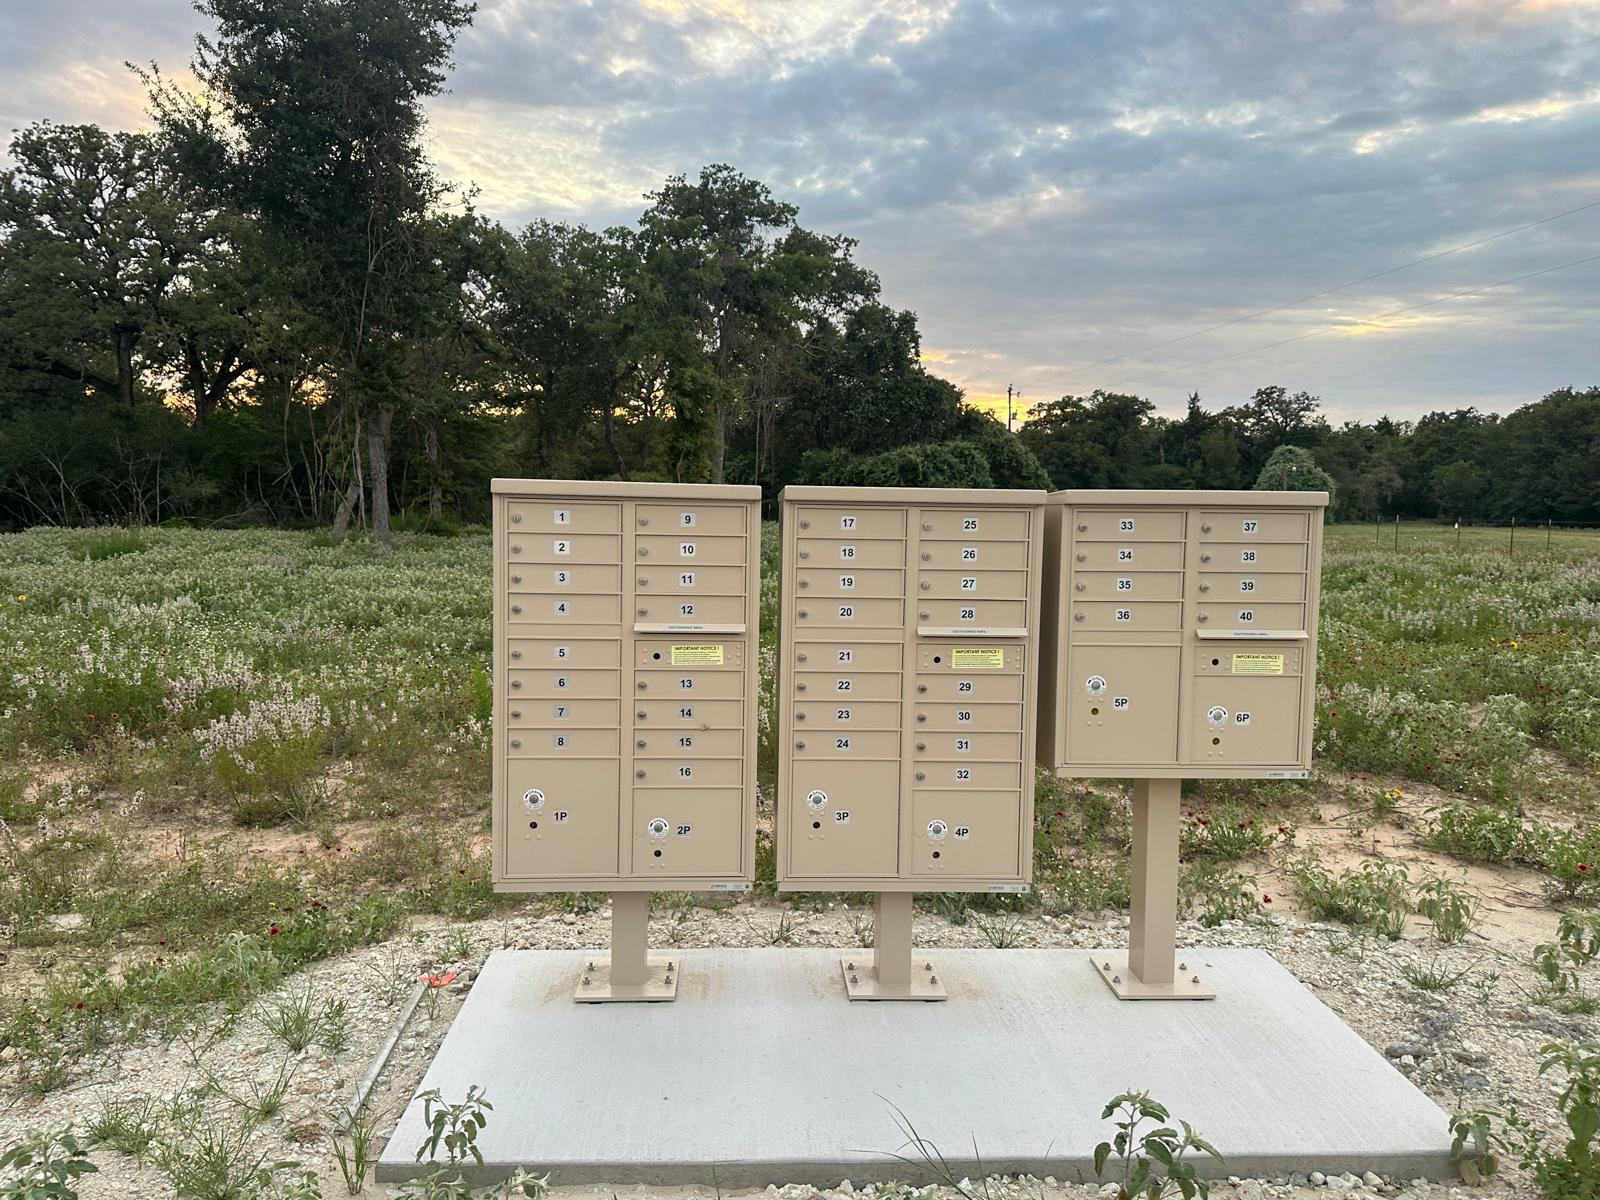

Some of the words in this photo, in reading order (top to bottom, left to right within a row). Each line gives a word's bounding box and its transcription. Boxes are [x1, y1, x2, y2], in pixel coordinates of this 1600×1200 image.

[558, 512, 566, 522] 1
[684, 515, 691, 524] 9
[842, 518, 854, 528] 17
[964, 520, 977, 530] 25
[1120, 521, 1133, 530] 33
[1244, 522, 1257, 531] 37
[558, 542, 565, 552] 2
[682, 545, 694, 554] 10
[842, 548, 854, 557] 18
[963, 550, 976, 559] 26
[1119, 551, 1132, 560] 34
[1243, 552, 1255, 561] 38
[559, 573, 566, 582] 3
[681, 575, 692, 584] 11
[841, 577, 853, 587] 19
[962, 579, 975, 588] 27
[1118, 580, 1131, 590] 35
[1241, 581, 1254, 591] 39
[558, 603, 565, 612] 4
[681, 605, 693, 614] 12
[840, 607, 852, 617] 20
[961, 609, 974, 619] 28
[1117, 610, 1130, 620] 36
[1239, 612, 1252, 621] 40
[559, 648, 565, 658] 5
[839, 651, 850, 661] 21
[558, 678, 565, 687] 6
[680, 679, 693, 688] 13
[838, 681, 850, 690] 22
[959, 682, 971, 692] 29
[1114, 698, 1128, 707] 5P
[558, 707, 565, 717] 7
[680, 708, 692, 717] 14
[837, 710, 850, 719] 23
[958, 711, 971, 721] 30
[1236, 713, 1250, 723] 6P
[557, 737, 564, 746] 8
[679, 737, 692, 747] 15
[836, 739, 849, 748] 24
[957, 740, 968, 750] 31
[679, 767, 691, 777] 16
[957, 770, 969, 779] 32
[554, 812, 567, 821] 1P
[836, 812, 849, 821] 3P
[677, 826, 691, 835] 2P
[955, 828, 969, 837] 4P
